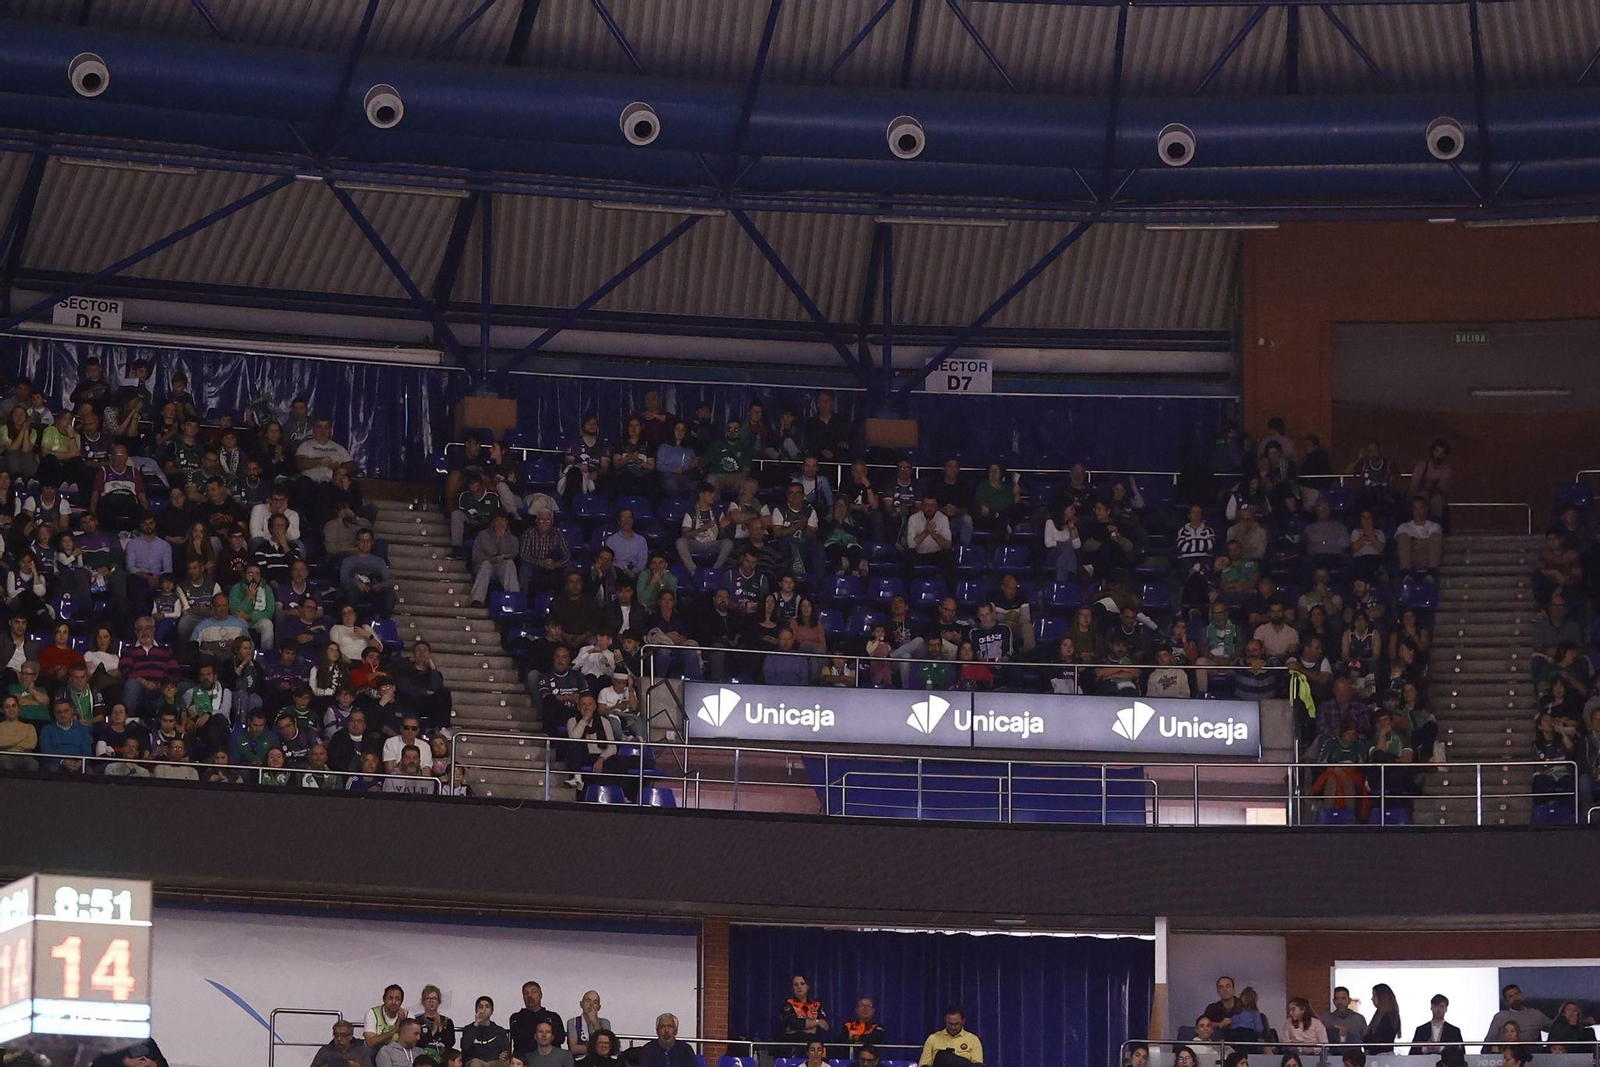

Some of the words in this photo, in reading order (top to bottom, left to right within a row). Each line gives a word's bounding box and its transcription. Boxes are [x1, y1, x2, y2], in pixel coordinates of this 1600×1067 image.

[60, 298, 119, 313] SECTOR
[76, 314, 101, 328] D6
[1455, 334, 1486, 343] SALIDA
[947, 375, 972, 390] D7
[745, 703, 835, 732] Unicaja
[954, 709, 1044, 739] Unicaja
[1159, 716, 1248, 745] Unicaja
[54, 886, 132, 920] 8:51
[51, 935, 136, 1000] 14
